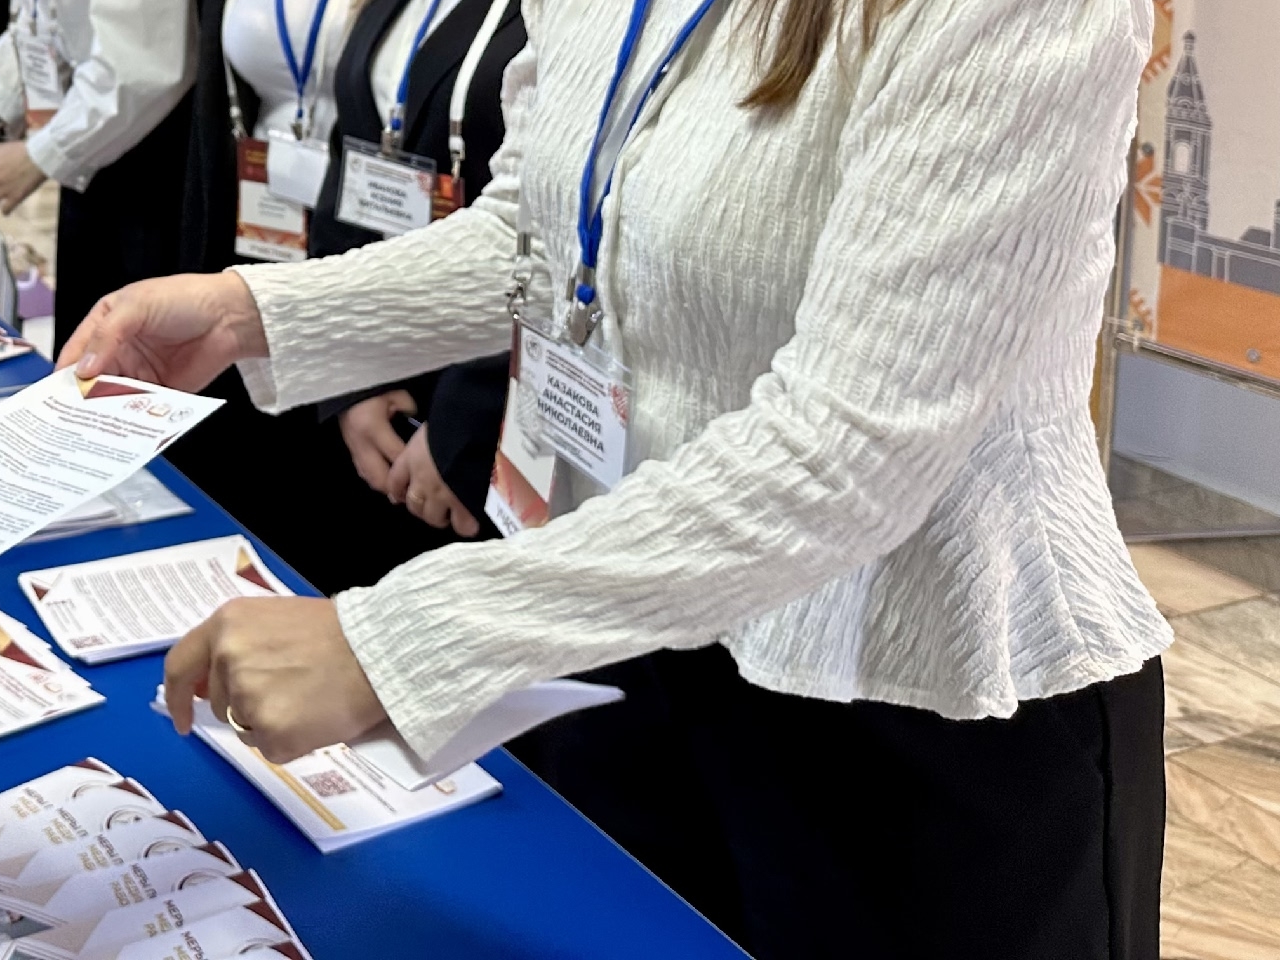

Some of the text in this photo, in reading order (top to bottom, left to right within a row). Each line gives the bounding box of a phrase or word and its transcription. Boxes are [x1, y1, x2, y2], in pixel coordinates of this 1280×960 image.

[542, 388, 602, 434] АНАСТАСИЯ
[547, 374, 600, 416] КАЗАКОВА
[537, 398, 606, 453] НИКОЛАЕВНА
